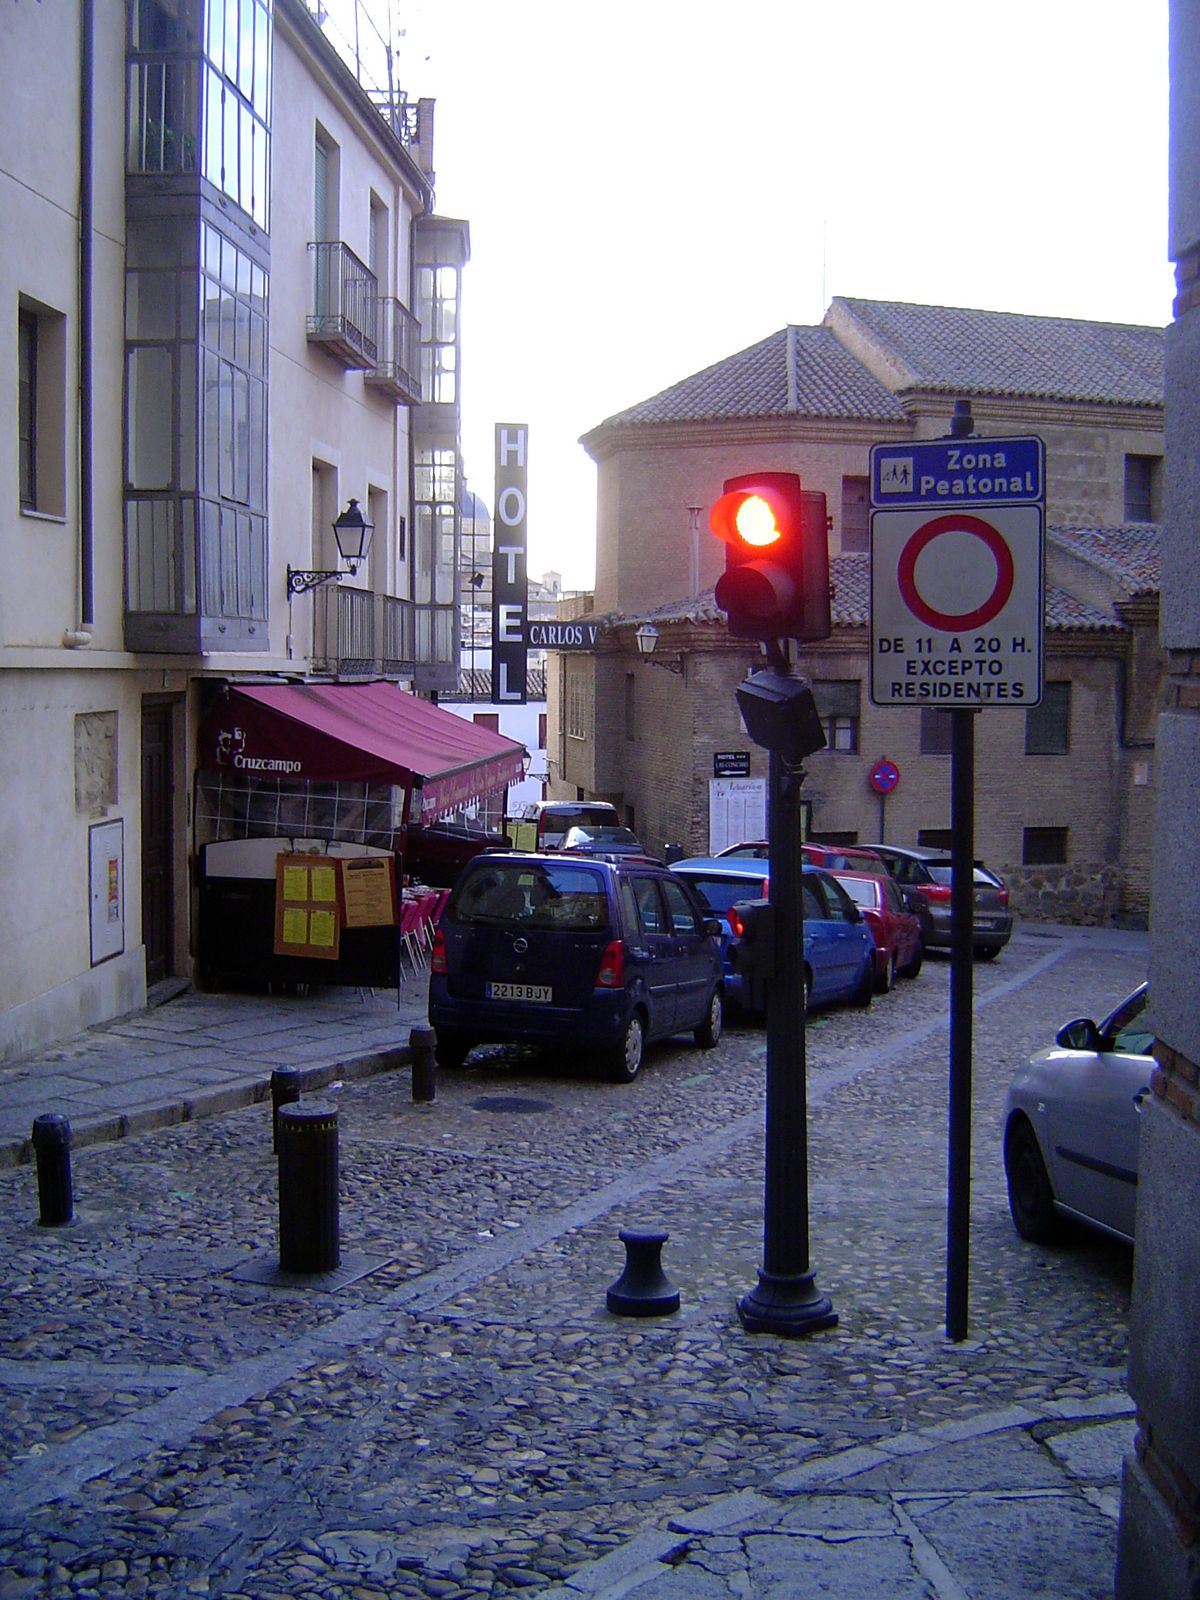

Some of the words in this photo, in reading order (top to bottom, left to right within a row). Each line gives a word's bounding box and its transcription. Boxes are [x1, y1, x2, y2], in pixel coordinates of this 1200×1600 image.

[947, 450, 1007, 470] Zona
[920, 472, 1034, 496] Peatonal
[498, 429, 526, 701] HOTEL
[530, 625, 583, 645] CARLOS
[588, 625, 598, 645] V
[878, 637, 904, 654] DE
[916, 637, 933, 653] 11
[949, 637, 963, 653] A
[974, 637, 1001, 653] 20
[906, 659, 1003, 676] EXCEPTO
[891, 682, 1024, 699] RESIDENTES
[234, 754, 302, 773] Cruzcampo
[493, 984, 523, 997] 2213
[526, 986, 549, 1000] BJY
